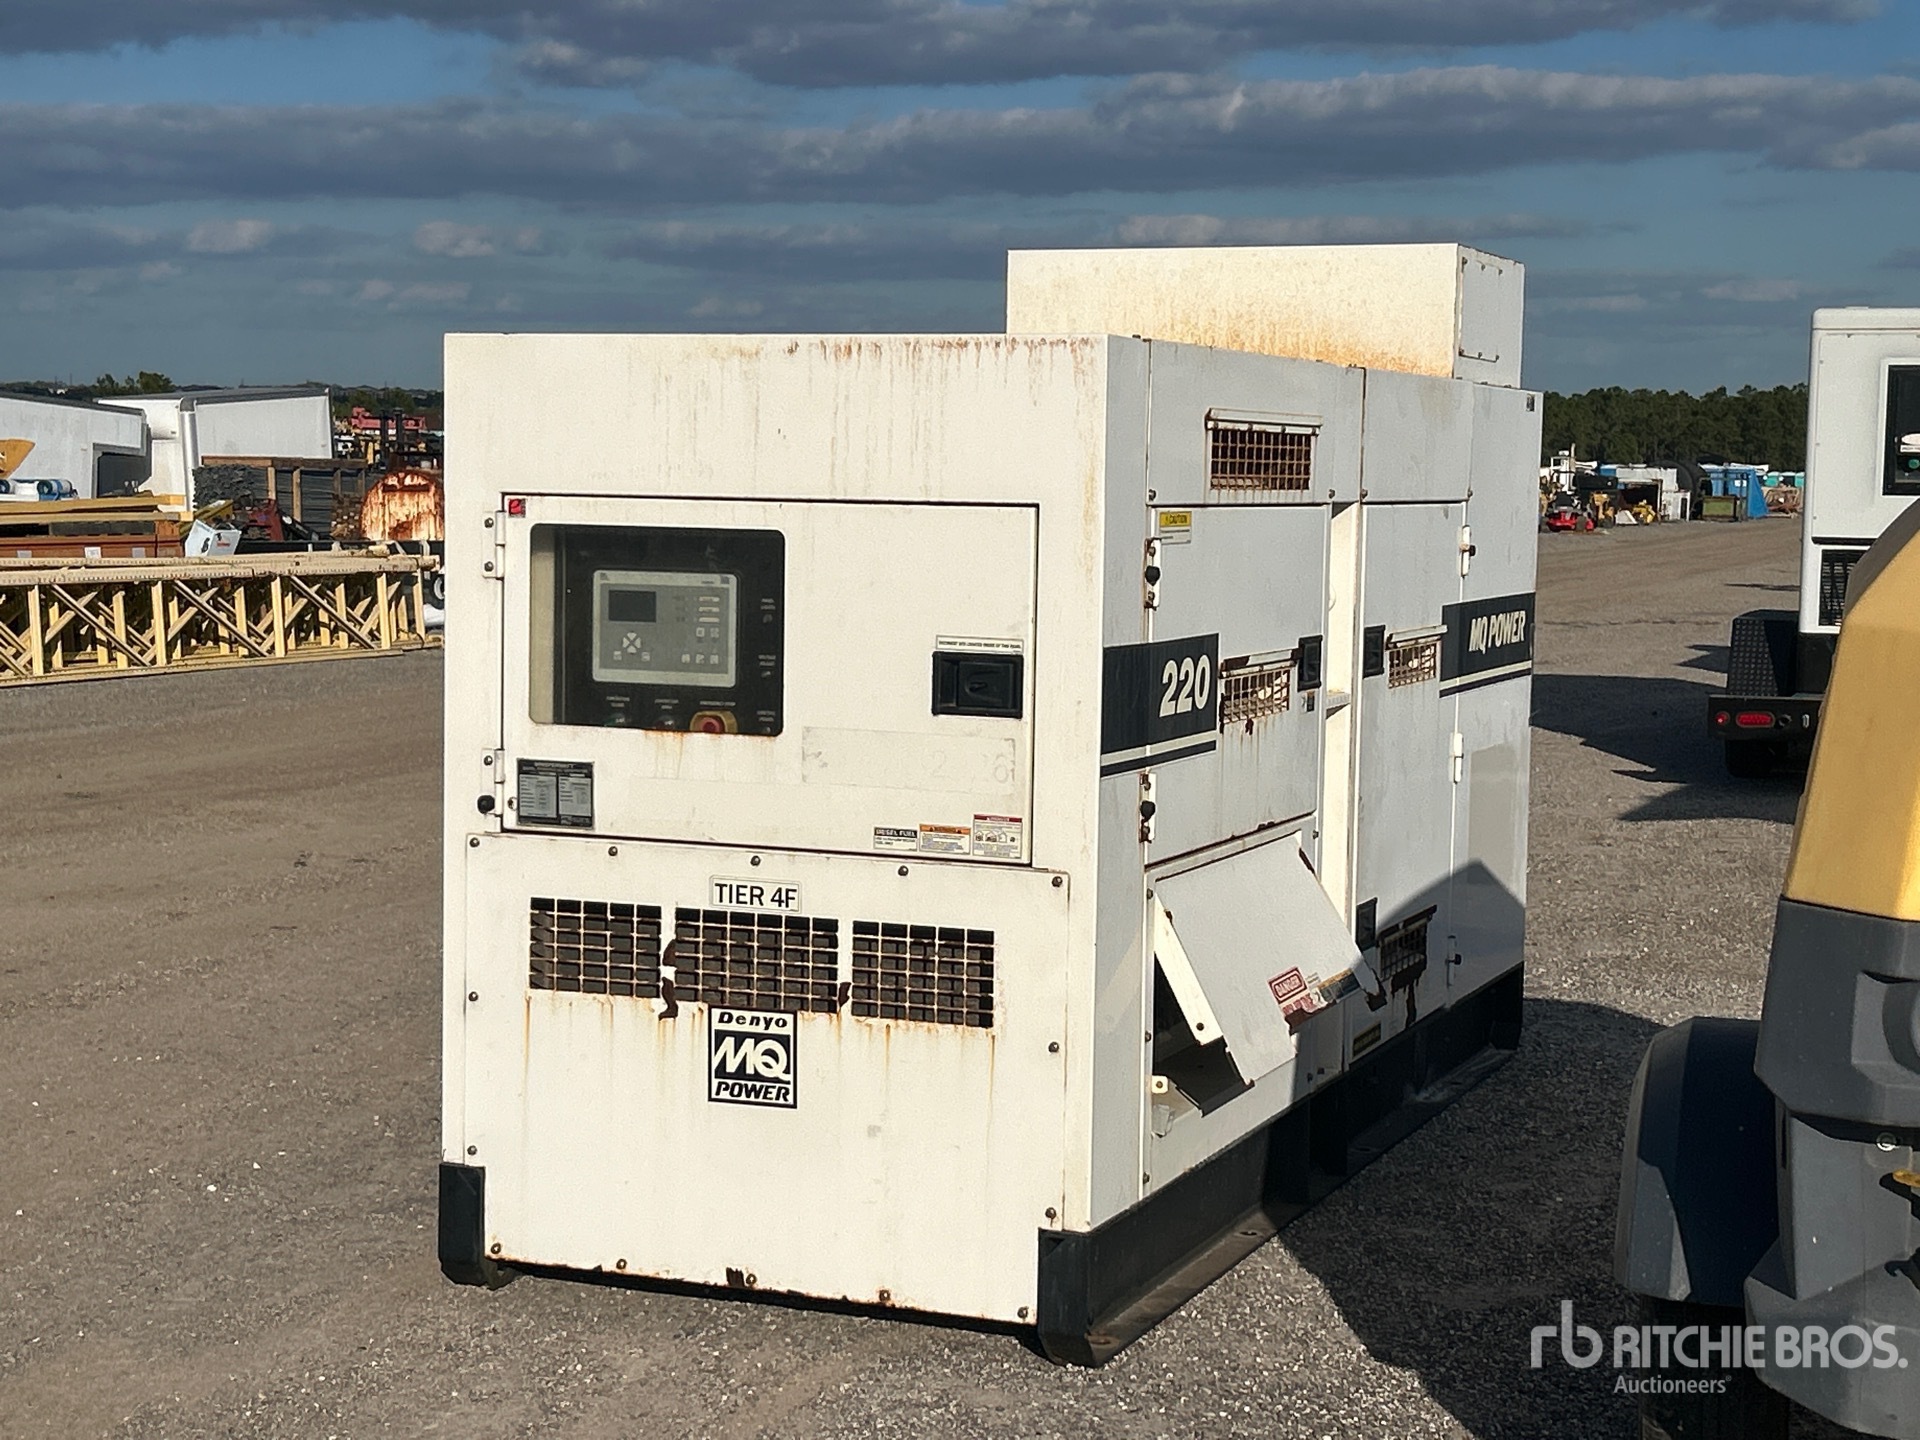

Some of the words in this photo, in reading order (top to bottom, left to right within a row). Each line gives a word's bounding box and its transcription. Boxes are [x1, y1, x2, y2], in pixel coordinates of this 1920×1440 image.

[1469, 616, 1488, 654] MQ
[1488, 610, 1526, 648] POWER
[1159, 654, 1211, 717] 220
[714, 882, 764, 906] TIER
[770, 887, 797, 908] 4F
[718, 1011, 788, 1031] Denyo
[714, 1036, 791, 1081] MQ
[714, 1081, 790, 1102] POWER
